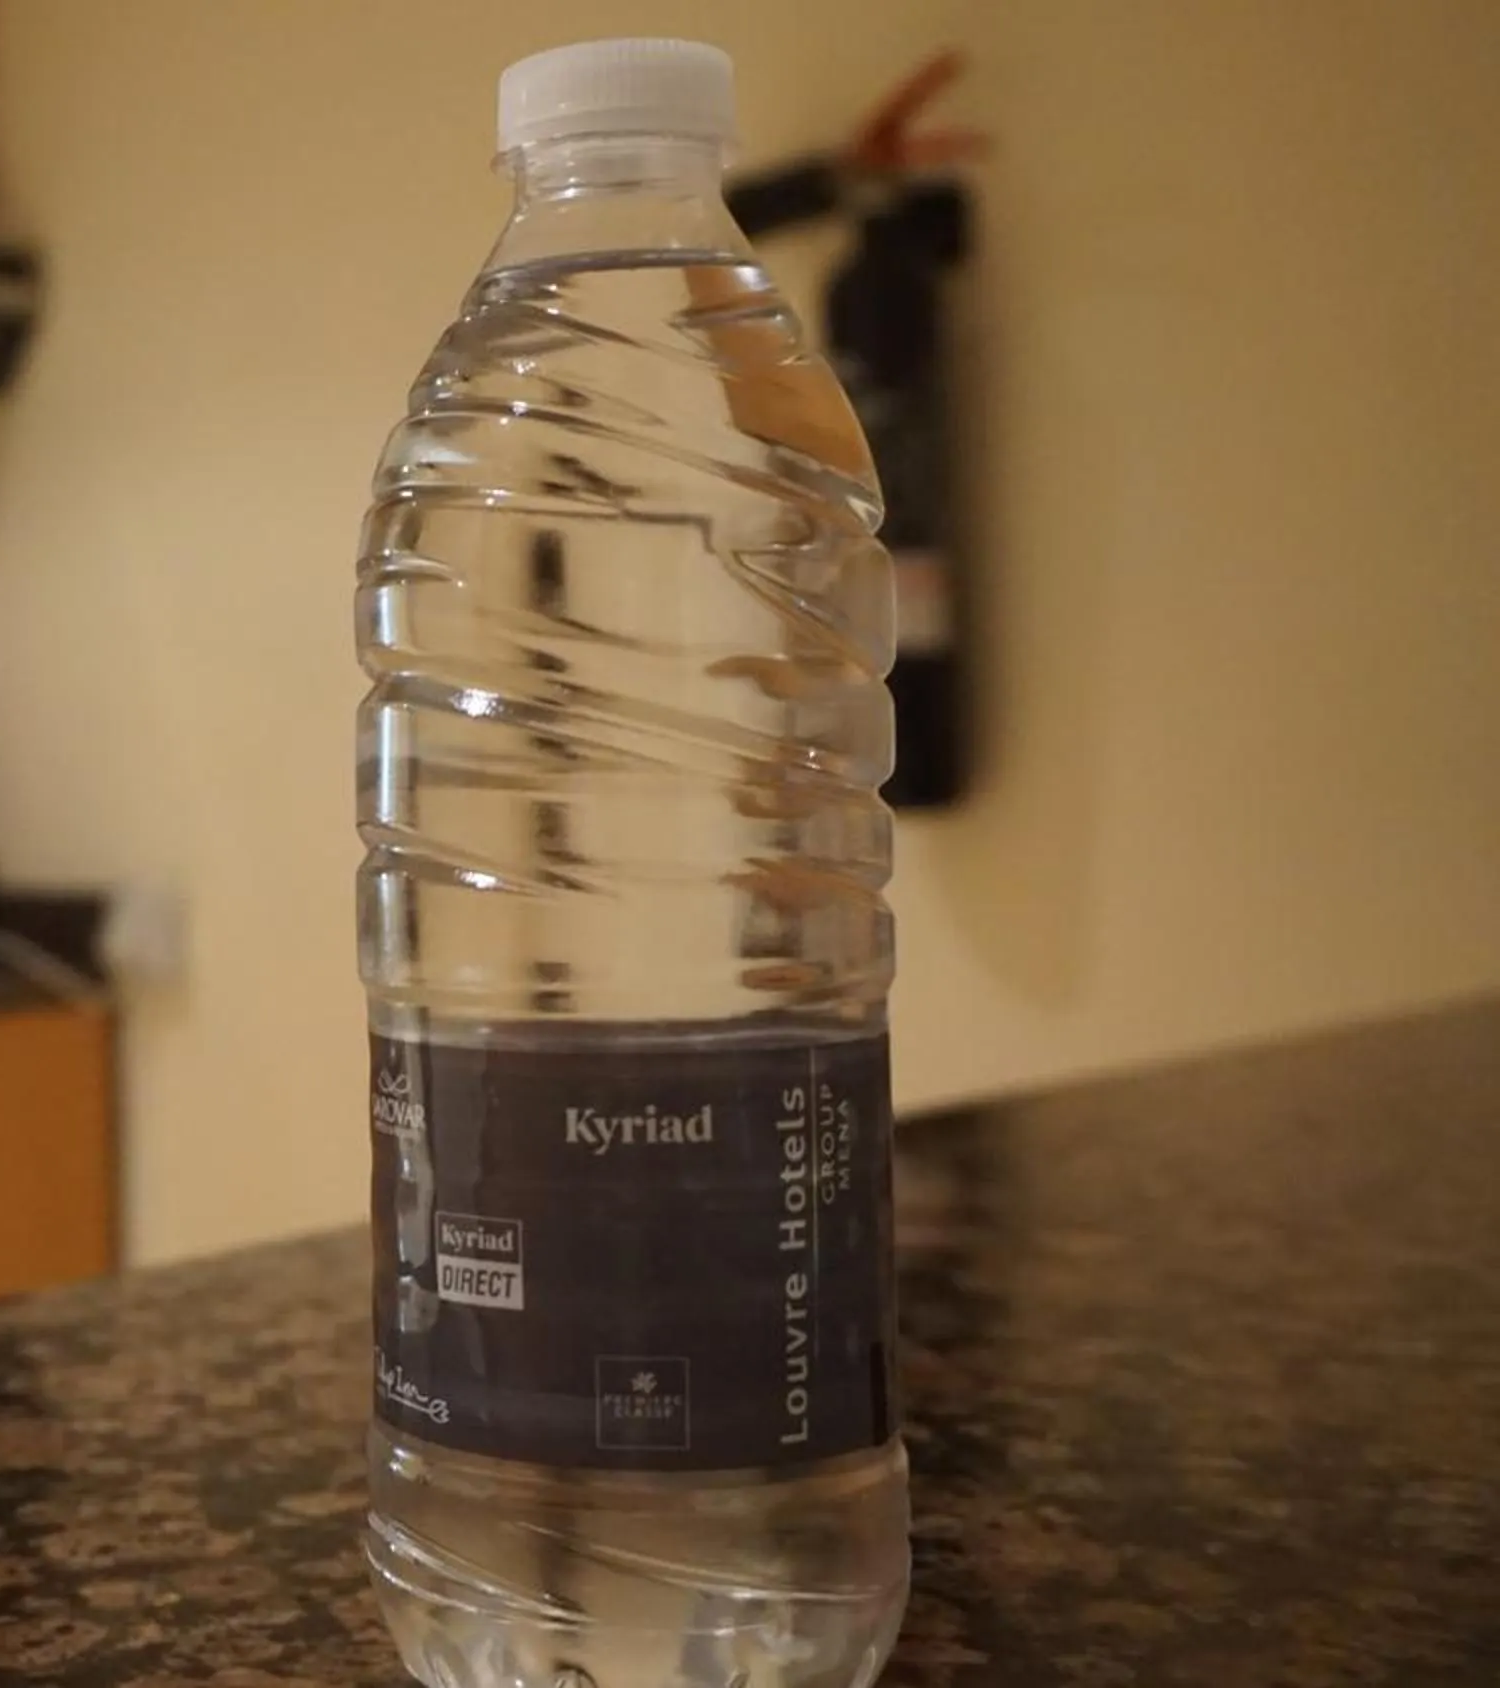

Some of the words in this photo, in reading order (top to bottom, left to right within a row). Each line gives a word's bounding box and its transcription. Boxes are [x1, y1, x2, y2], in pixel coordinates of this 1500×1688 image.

[565, 1104, 713, 1156] Kyriad
[775, 1087, 807, 1250] Hotels
[820, 1084, 835, 1204] GROUP
[837, 1100, 850, 1190] MENA
[441, 1223, 514, 1253] Kyriad
[442, 1264, 517, 1299] DIRECT
[780, 1273, 808, 1444] Louvre
